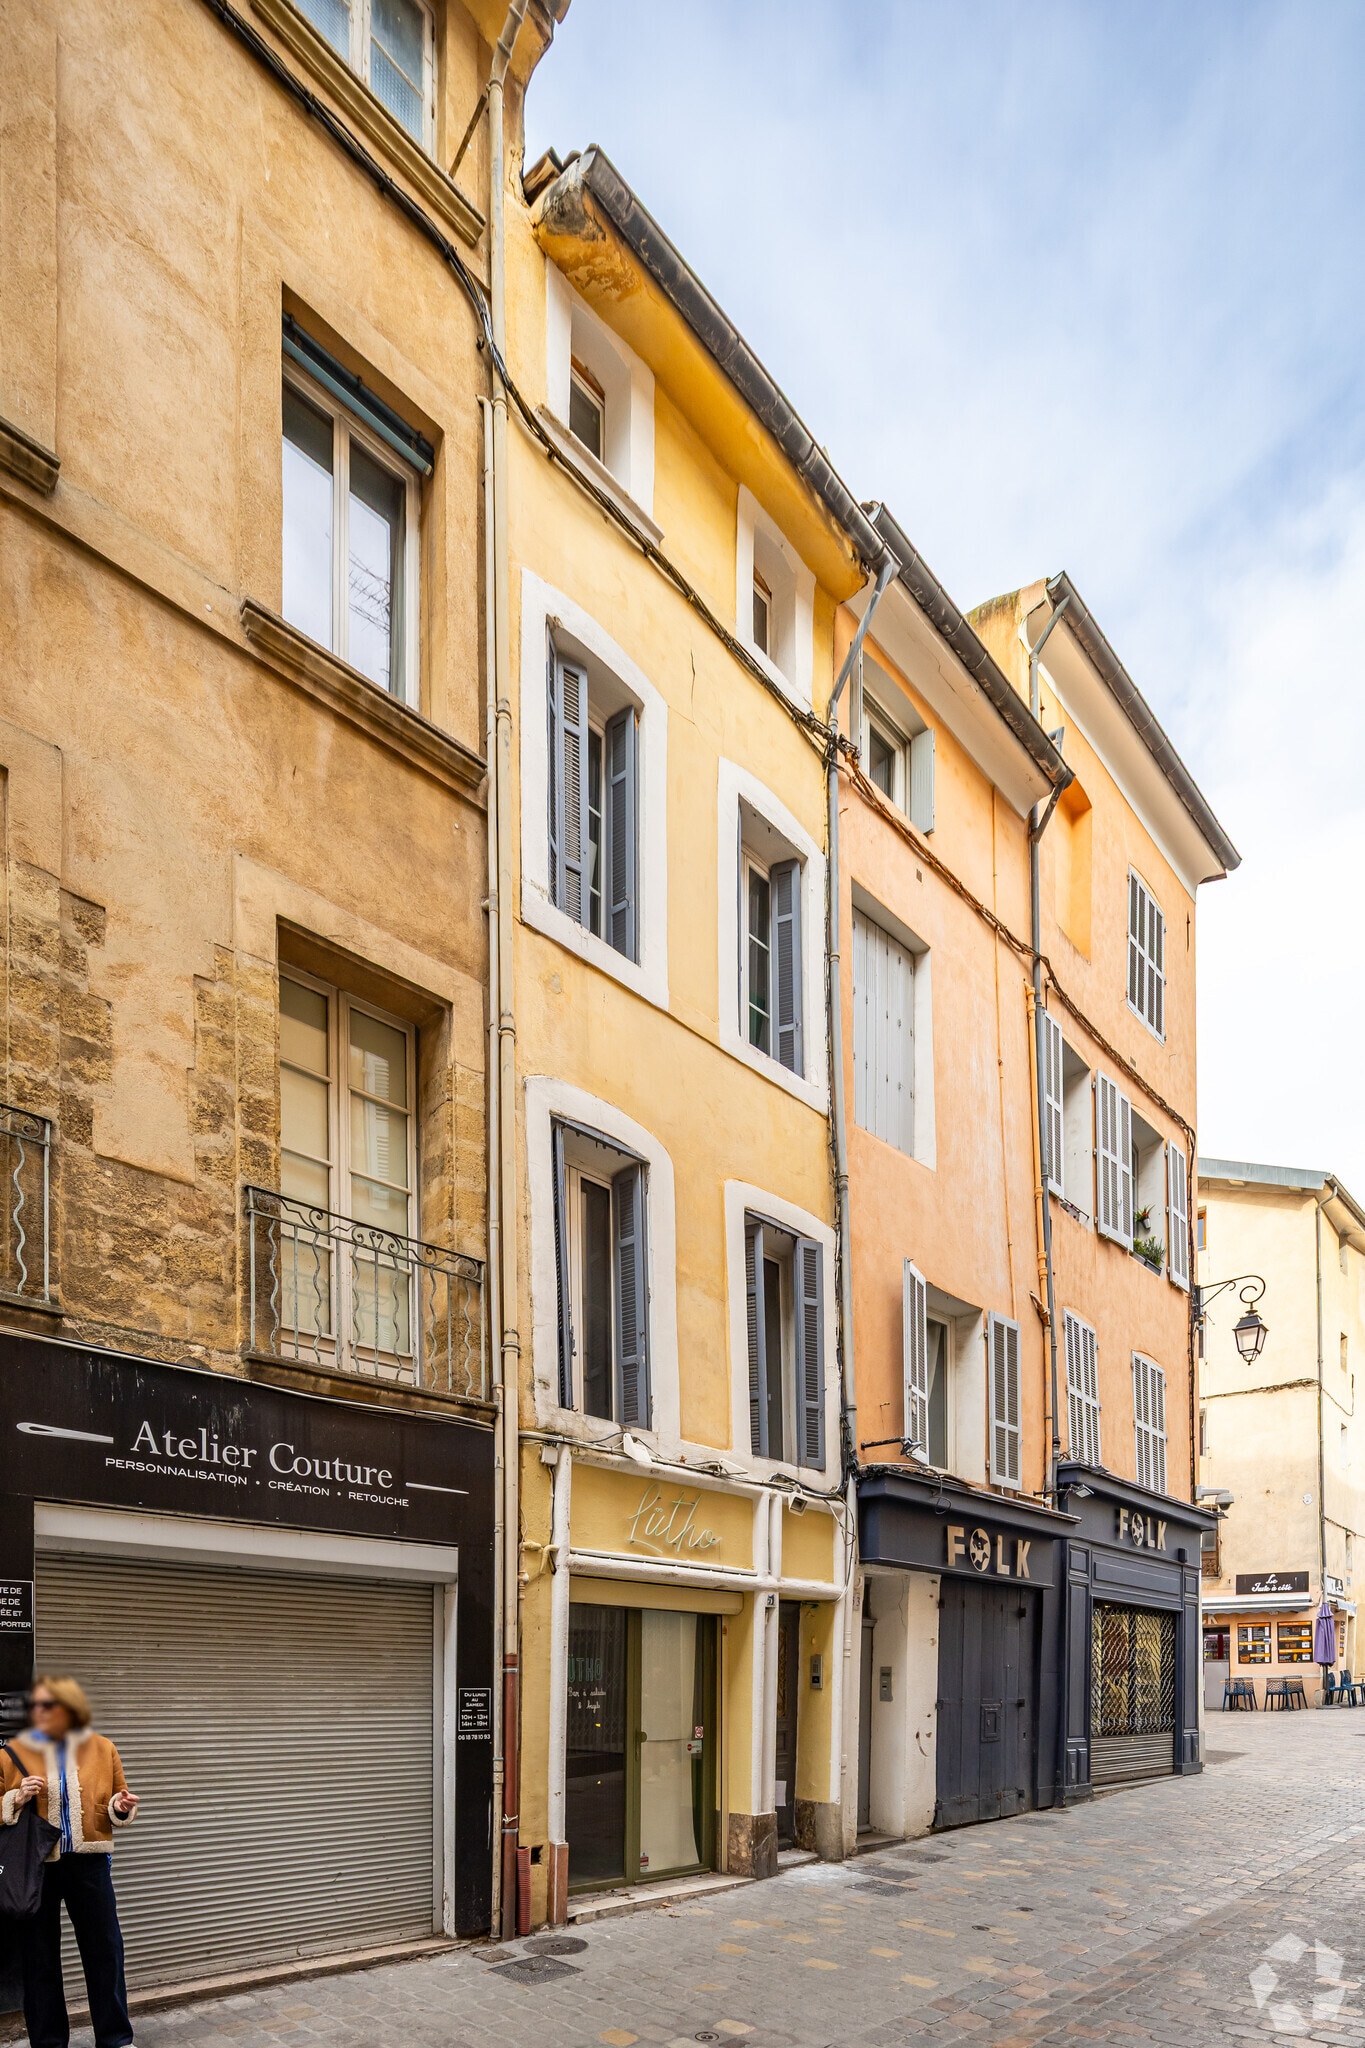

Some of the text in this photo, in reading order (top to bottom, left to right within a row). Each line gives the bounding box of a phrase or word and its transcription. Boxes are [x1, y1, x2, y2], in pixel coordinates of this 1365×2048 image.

[130, 1420, 393, 1489] Atelier Couture
[105, 1458, 410, 1507] PERSONNALISATION CRÉATION RETOUCHE
[626, 1481, 723, 1554] Lütho
[1119, 1507, 1168, 1551] FOLK
[947, 1525, 1031, 1579] FOLK
[0, 1597, 7, 1605] E
[10, 1587, 22, 1595] DE
